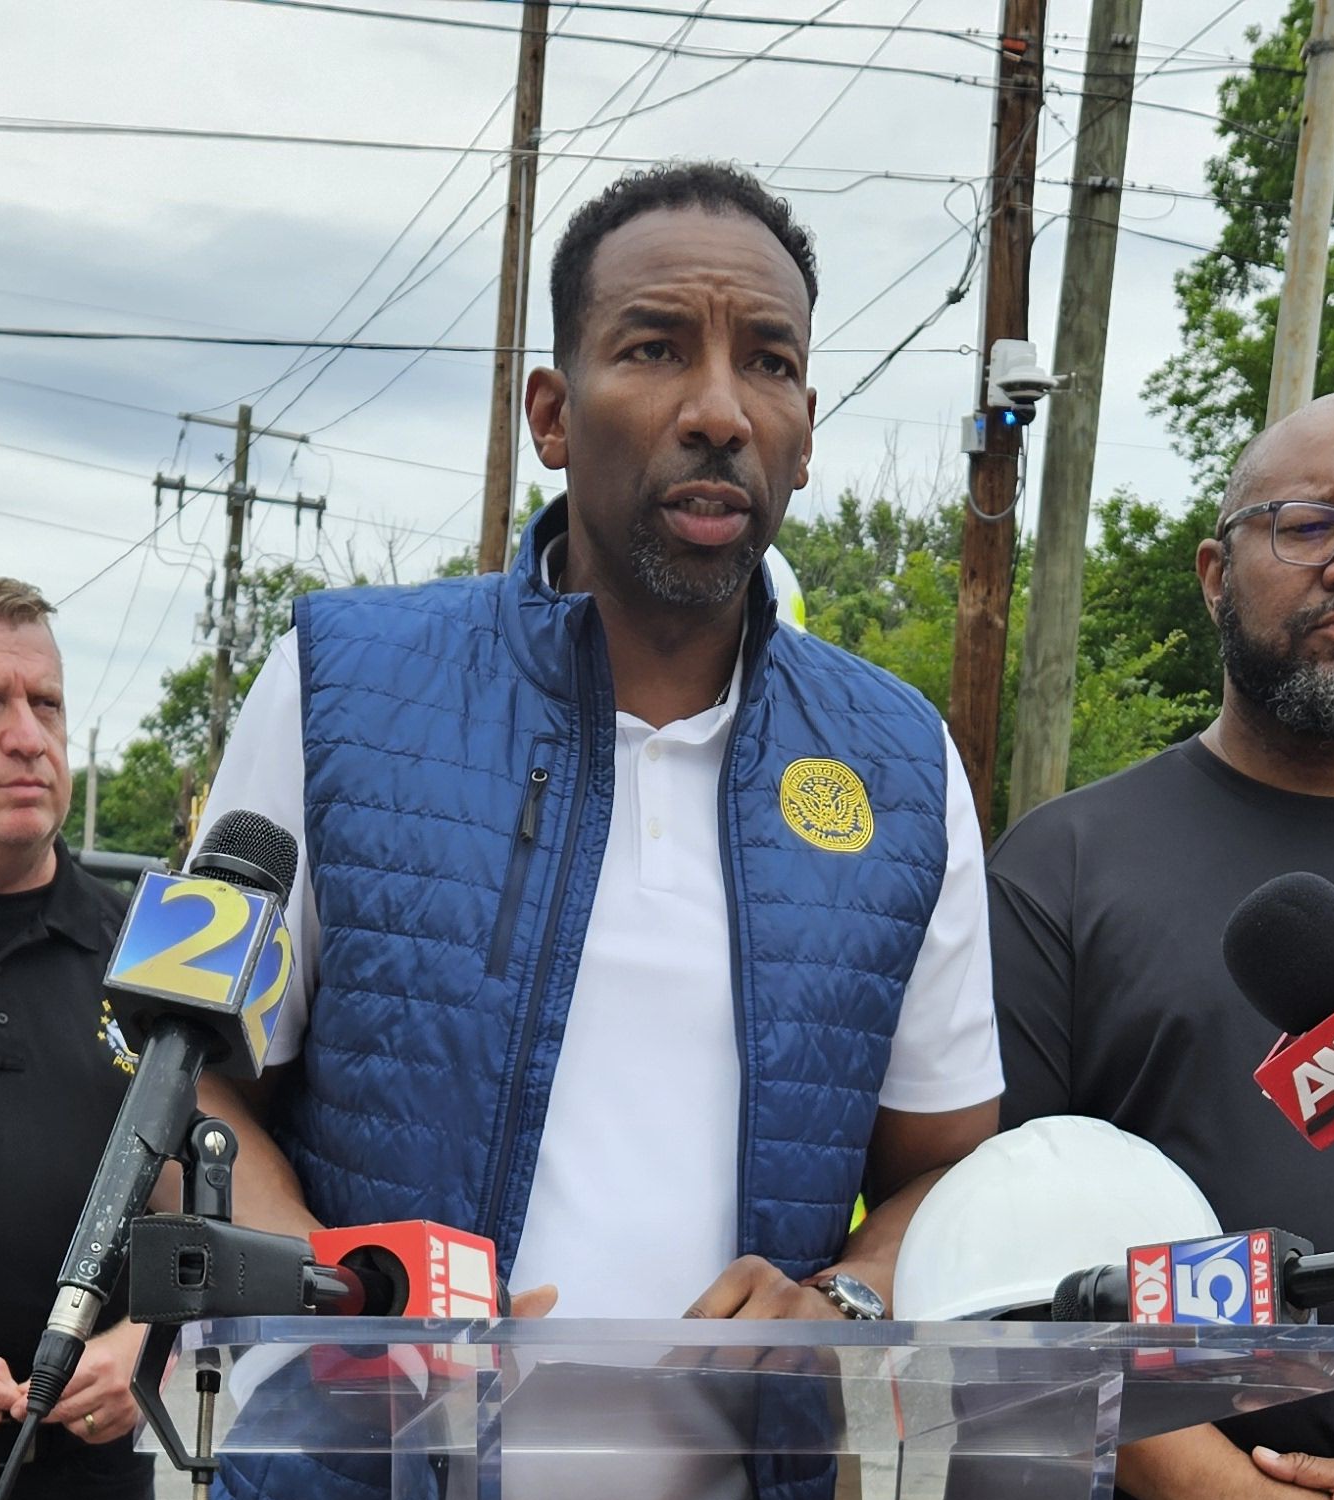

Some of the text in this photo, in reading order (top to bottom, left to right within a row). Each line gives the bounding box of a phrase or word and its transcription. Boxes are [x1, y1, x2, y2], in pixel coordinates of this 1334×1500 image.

[114, 879, 250, 1004] 2
[1174, 1257, 1247, 1320] 5
[1252, 1237, 1271, 1326] NEWS
